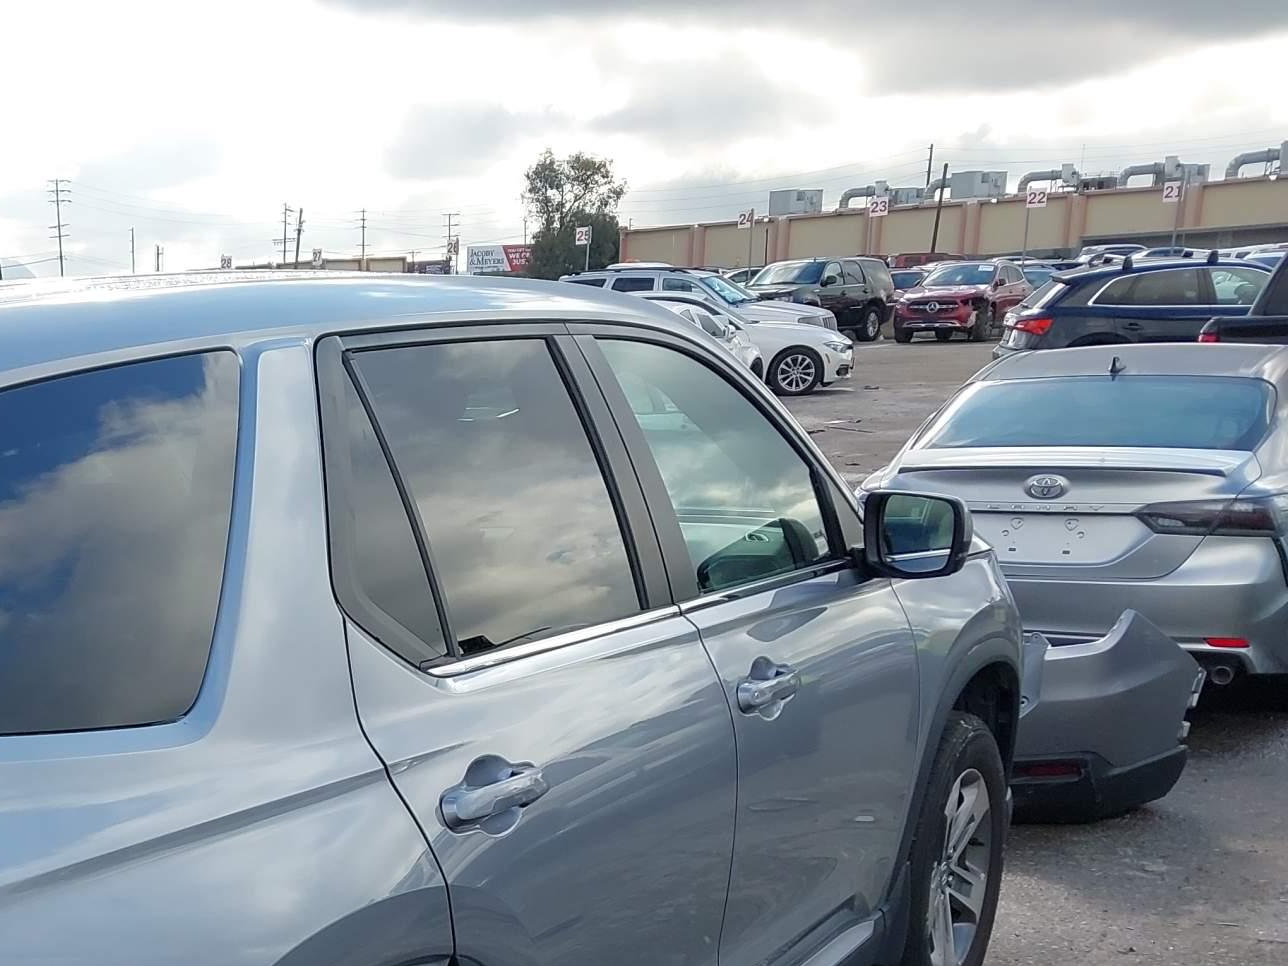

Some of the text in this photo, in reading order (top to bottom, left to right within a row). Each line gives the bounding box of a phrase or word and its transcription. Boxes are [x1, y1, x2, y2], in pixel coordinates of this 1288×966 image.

[1028, 191, 1046, 204] 22
[1164, 185, 1181, 199] 21
[871, 200, 887, 213] 23
[739, 212, 753, 225] 24
[577, 230, 590, 241] 25
